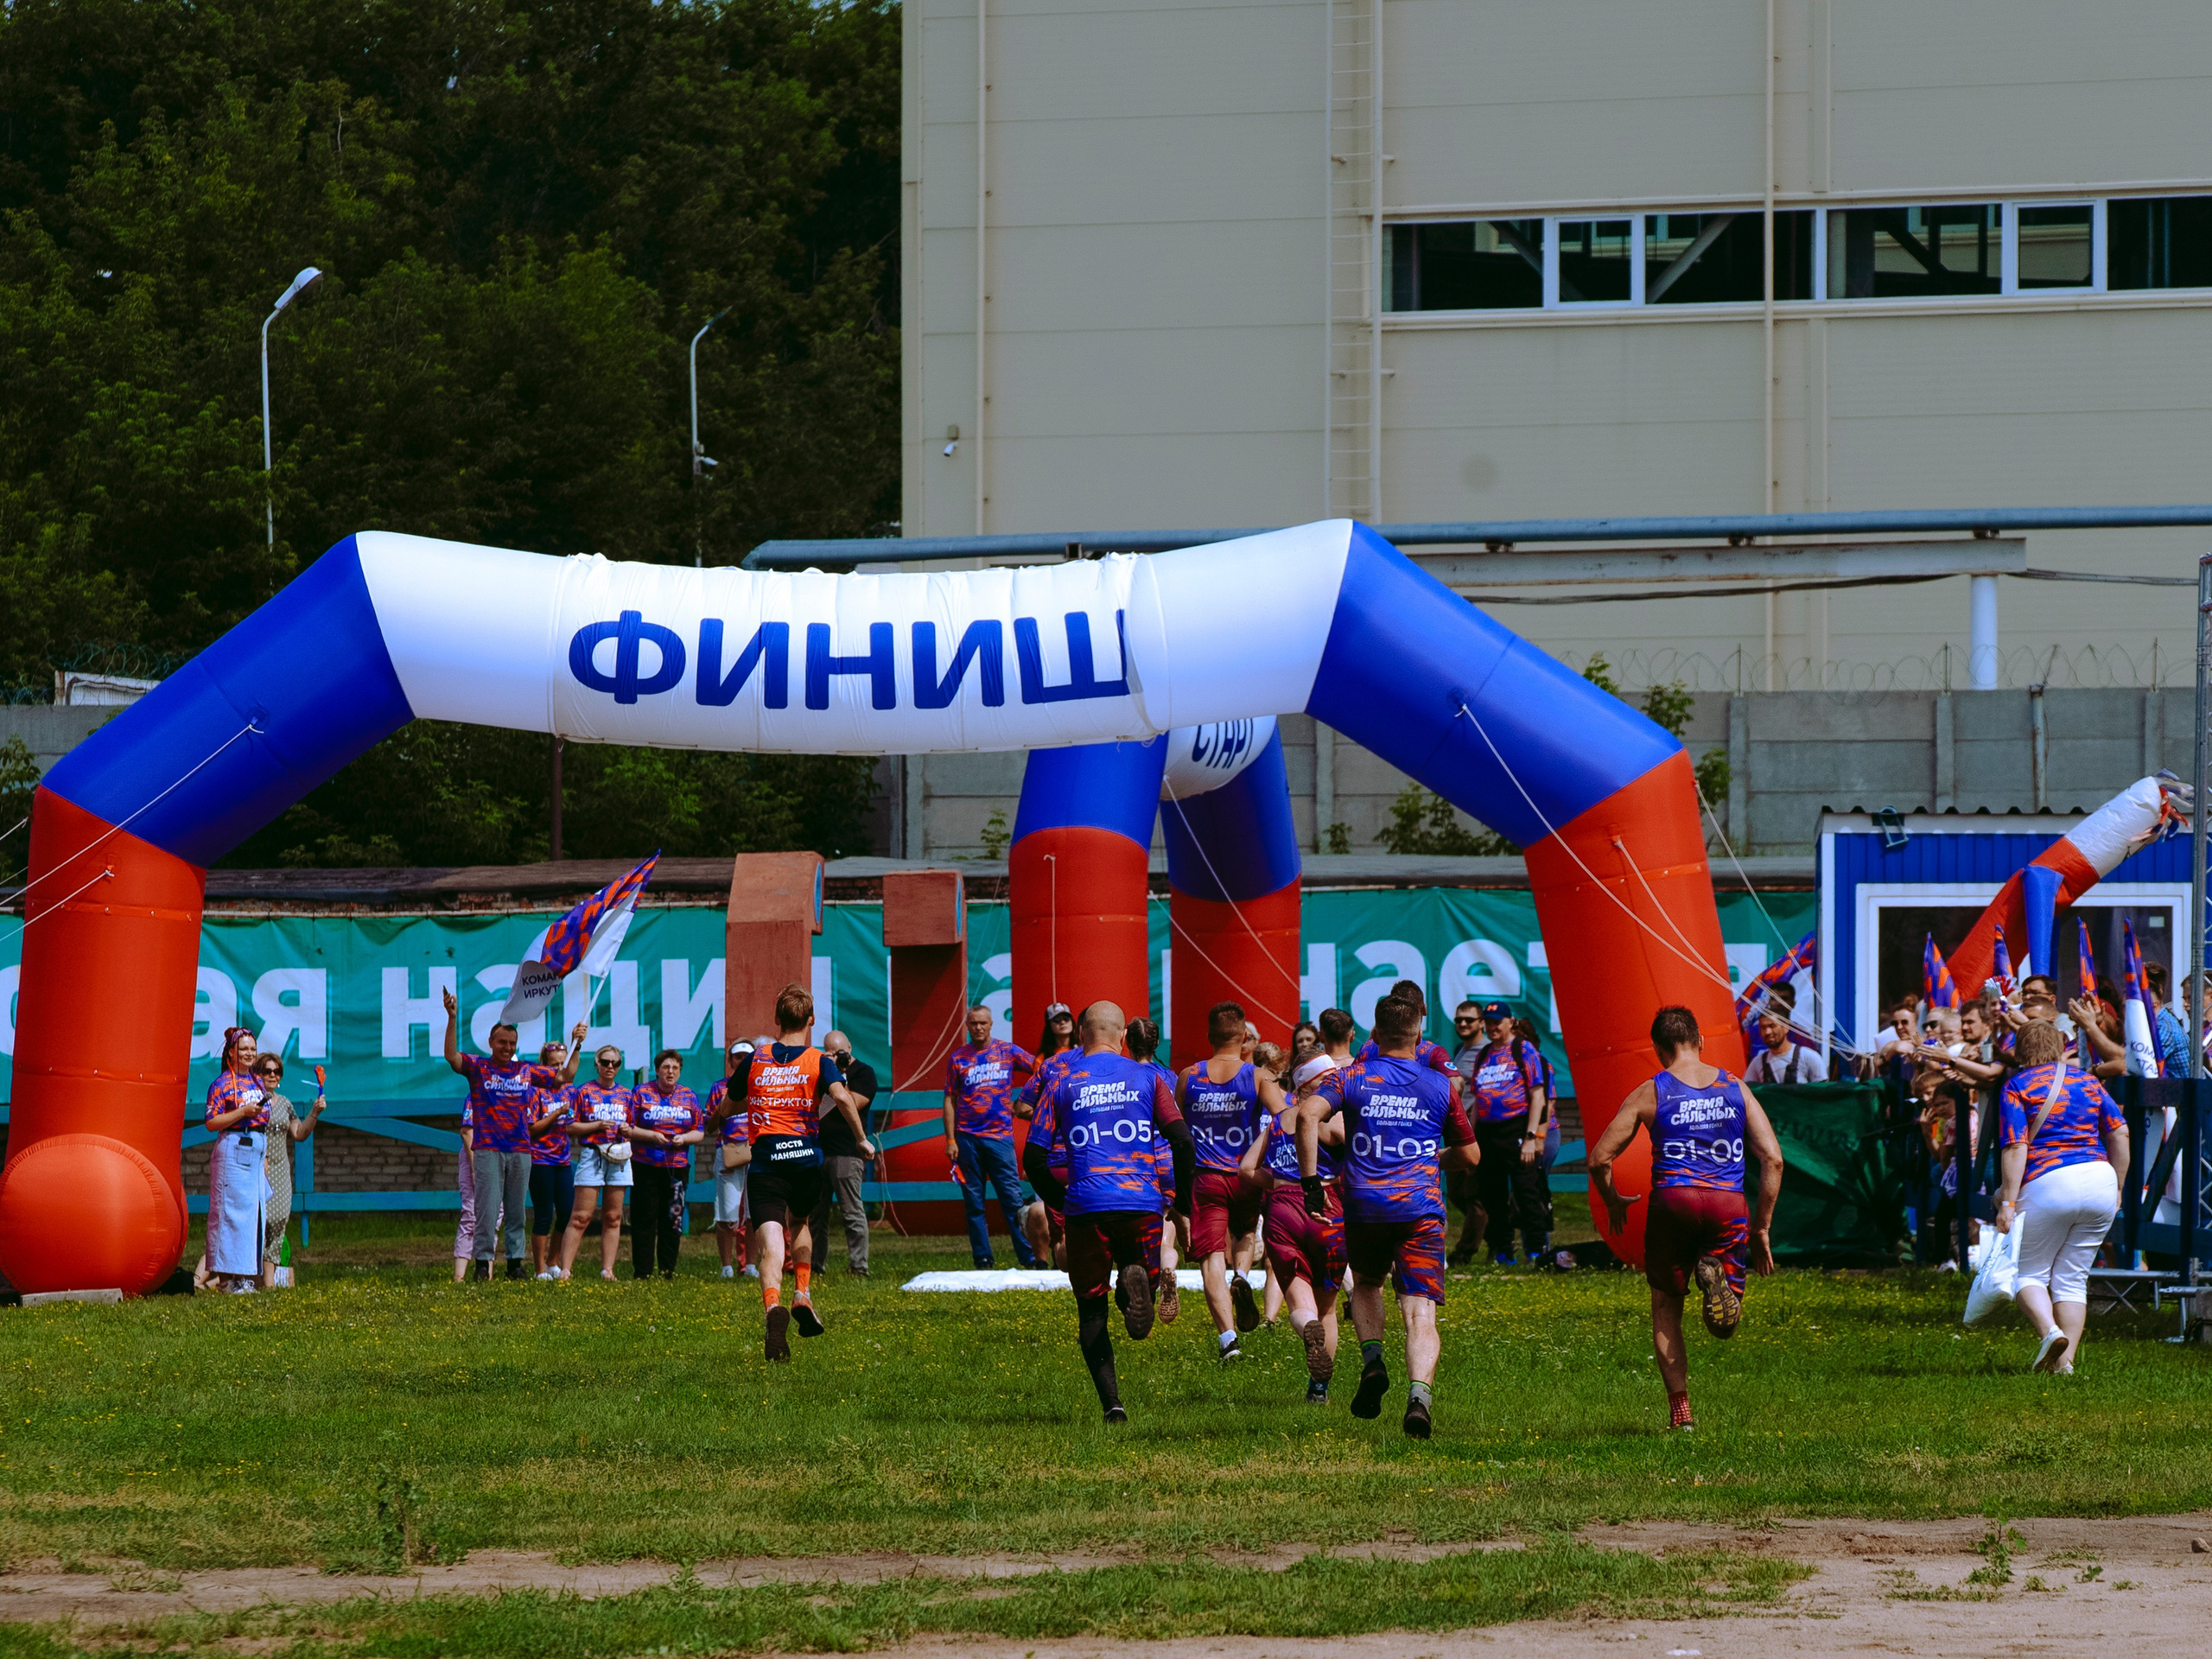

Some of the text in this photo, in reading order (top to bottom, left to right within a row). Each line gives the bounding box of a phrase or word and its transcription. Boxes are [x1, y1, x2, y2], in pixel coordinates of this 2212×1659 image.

[569, 609, 1130, 710] ФИНИШ
[524, 983, 561, 999] ИРКУТ
[2131, 1040, 2155, 1058] КОМ
[762, 1065, 800, 1077] ВРЕМЯ
[968, 1062, 1001, 1077] ВРЕМЯ
[754, 1074, 810, 1086] СИЛЬНЫХ
[964, 1070, 1009, 1086] СИЛЬНЫХ
[1080, 1081, 1126, 1098] ВРЕМЯ
[1198, 1091, 1237, 1103] ВРЕМЯ
[1072, 1090, 1140, 1111] СИЛЬНЫХ
[1192, 1100, 1248, 1112] СИЛЬНЫХ
[1370, 1094, 1418, 1108] ВРЕМЯ
[1679, 1096, 1724, 1113] ВРЕМЯ
[588, 1110, 627, 1122] СИЛЬНЫ
[752, 1112, 771, 1125] 01
[1360, 1105, 1430, 1121] СИЛЬНЫХ
[1670, 1107, 1737, 1126] СИЛЬНЫХ
[1069, 1119, 1152, 1148] 01-05
[1192, 1124, 1254, 1147] 01-01
[776, 1140, 803, 1150] КОСТЯ
[1663, 1138, 1744, 1163] 01-09
[771, 1147, 814, 1160] МАНЯШИН
